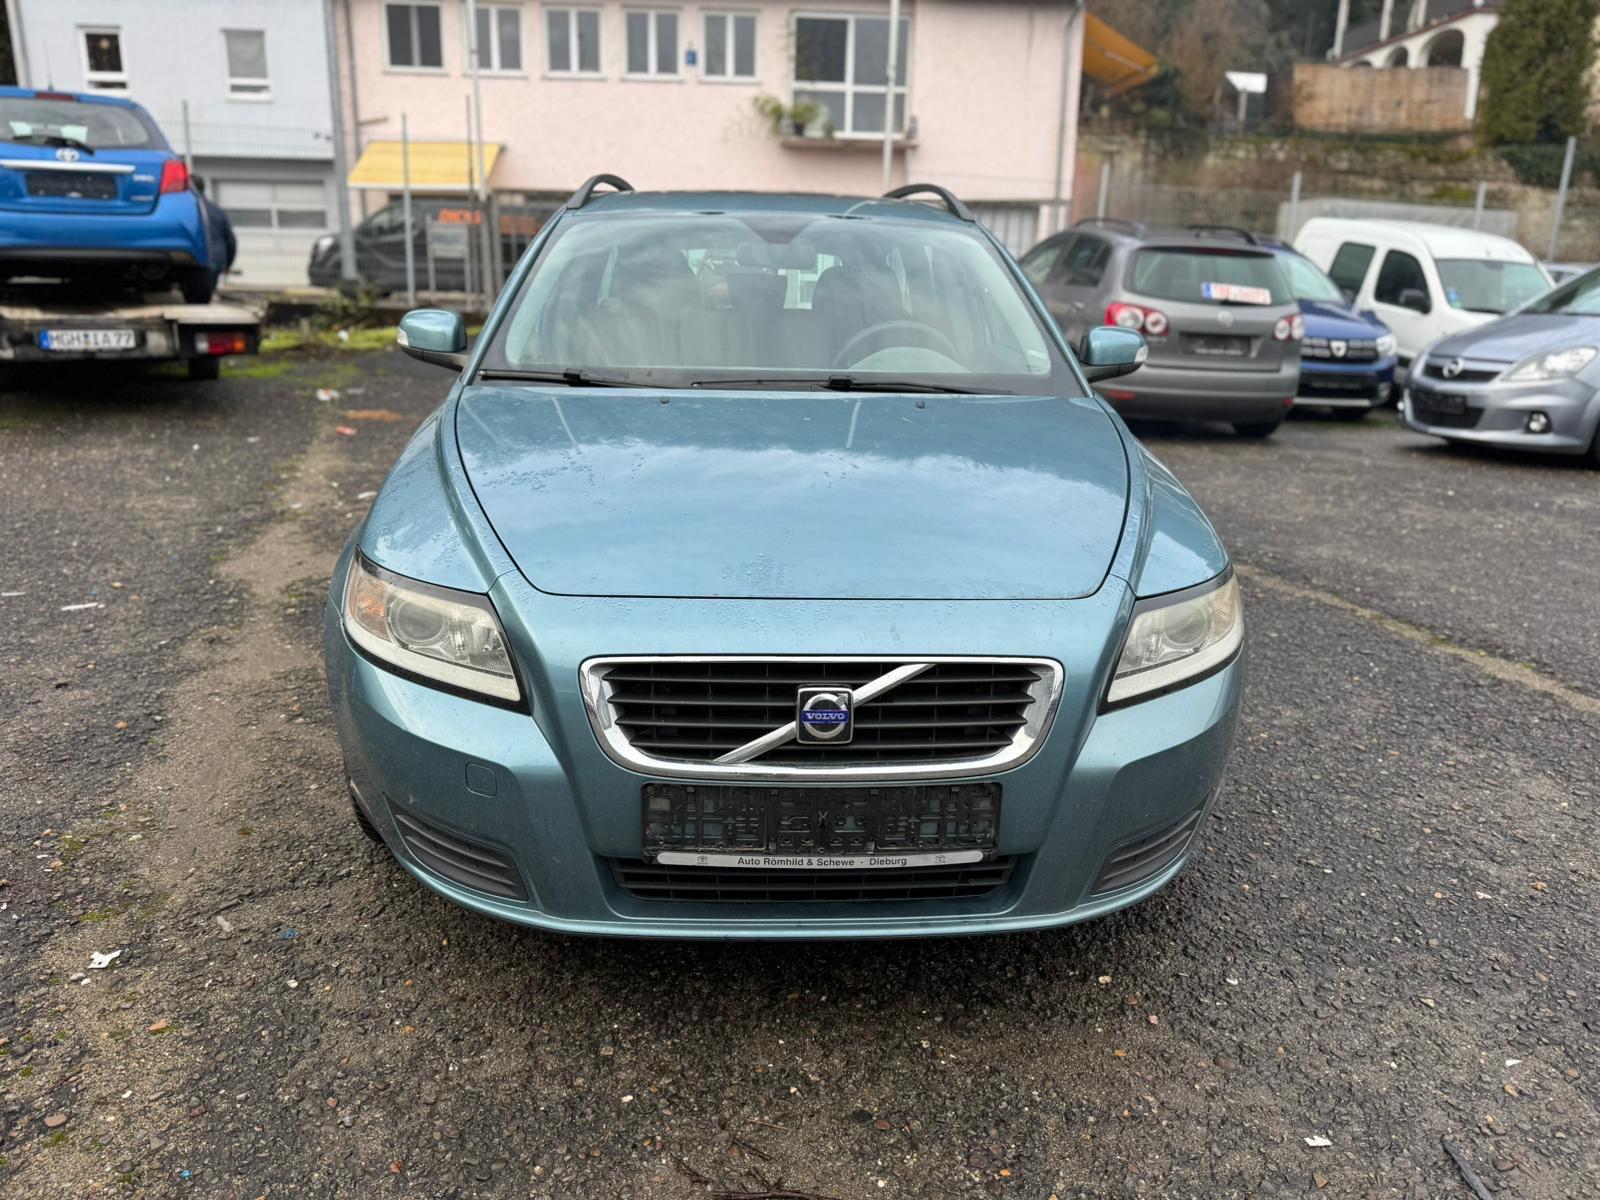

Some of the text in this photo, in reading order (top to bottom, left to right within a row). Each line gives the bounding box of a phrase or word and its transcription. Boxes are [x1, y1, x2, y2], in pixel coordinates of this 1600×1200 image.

[805, 712, 845, 720] VOLVO
[737, 856, 761, 866] Auto
[763, 856, 804, 867] Römhild
[806, 857, 814, 867] &
[816, 857, 855, 867] Schewe
[869, 856, 907, 867] Dieburg
